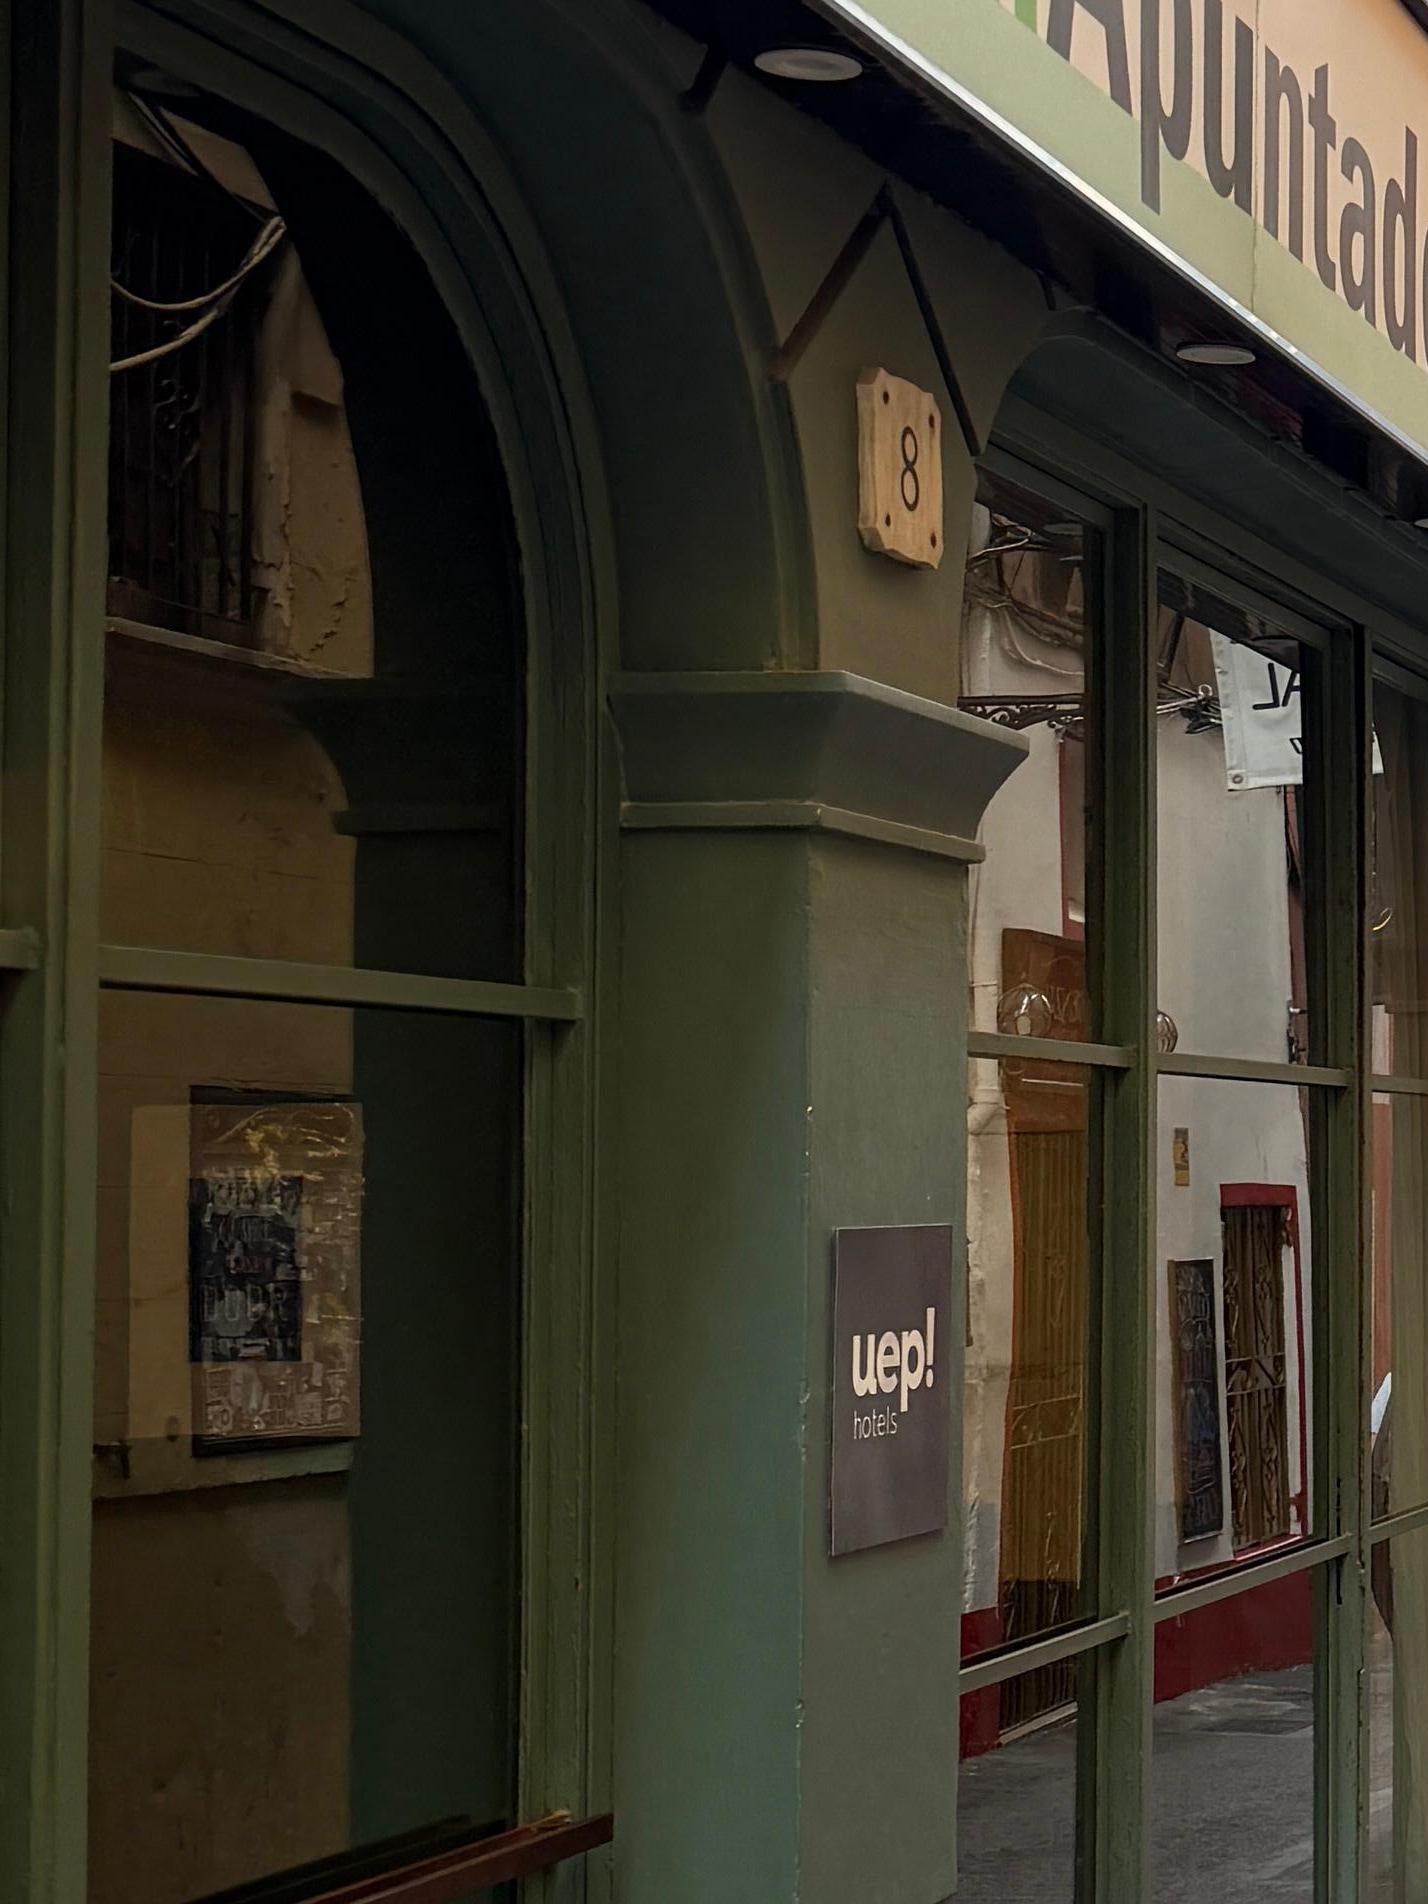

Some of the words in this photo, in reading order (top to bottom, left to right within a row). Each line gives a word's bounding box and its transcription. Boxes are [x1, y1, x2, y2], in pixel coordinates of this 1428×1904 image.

[901, 425, 920, 512] 8
[852, 1306, 937, 1413] uep!
[853, 1405, 899, 1440] hotels
